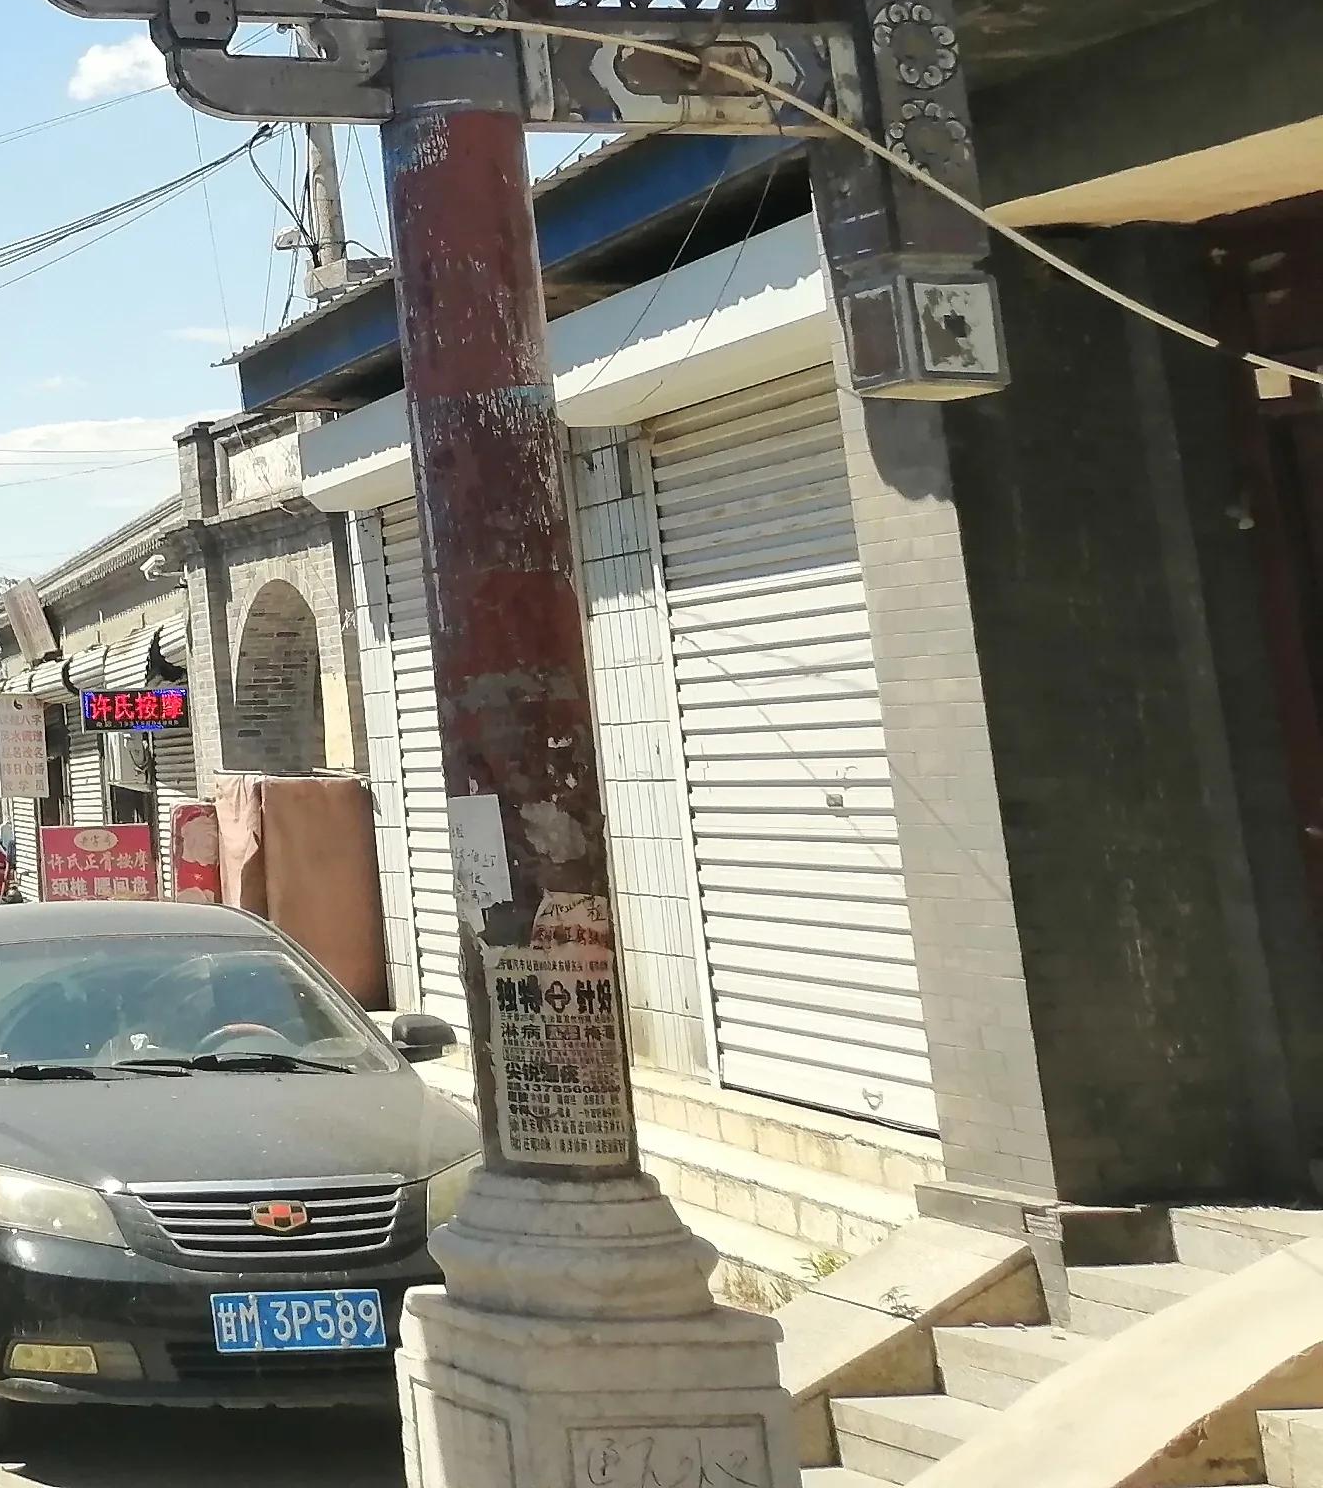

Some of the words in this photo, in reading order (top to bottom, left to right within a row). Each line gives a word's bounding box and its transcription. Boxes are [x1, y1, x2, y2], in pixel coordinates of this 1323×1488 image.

[90, 692, 184, 721] 许氏按摩
[47, 849, 148, 873] 许氏正骨按摩
[51, 876, 88, 897] 颈椎
